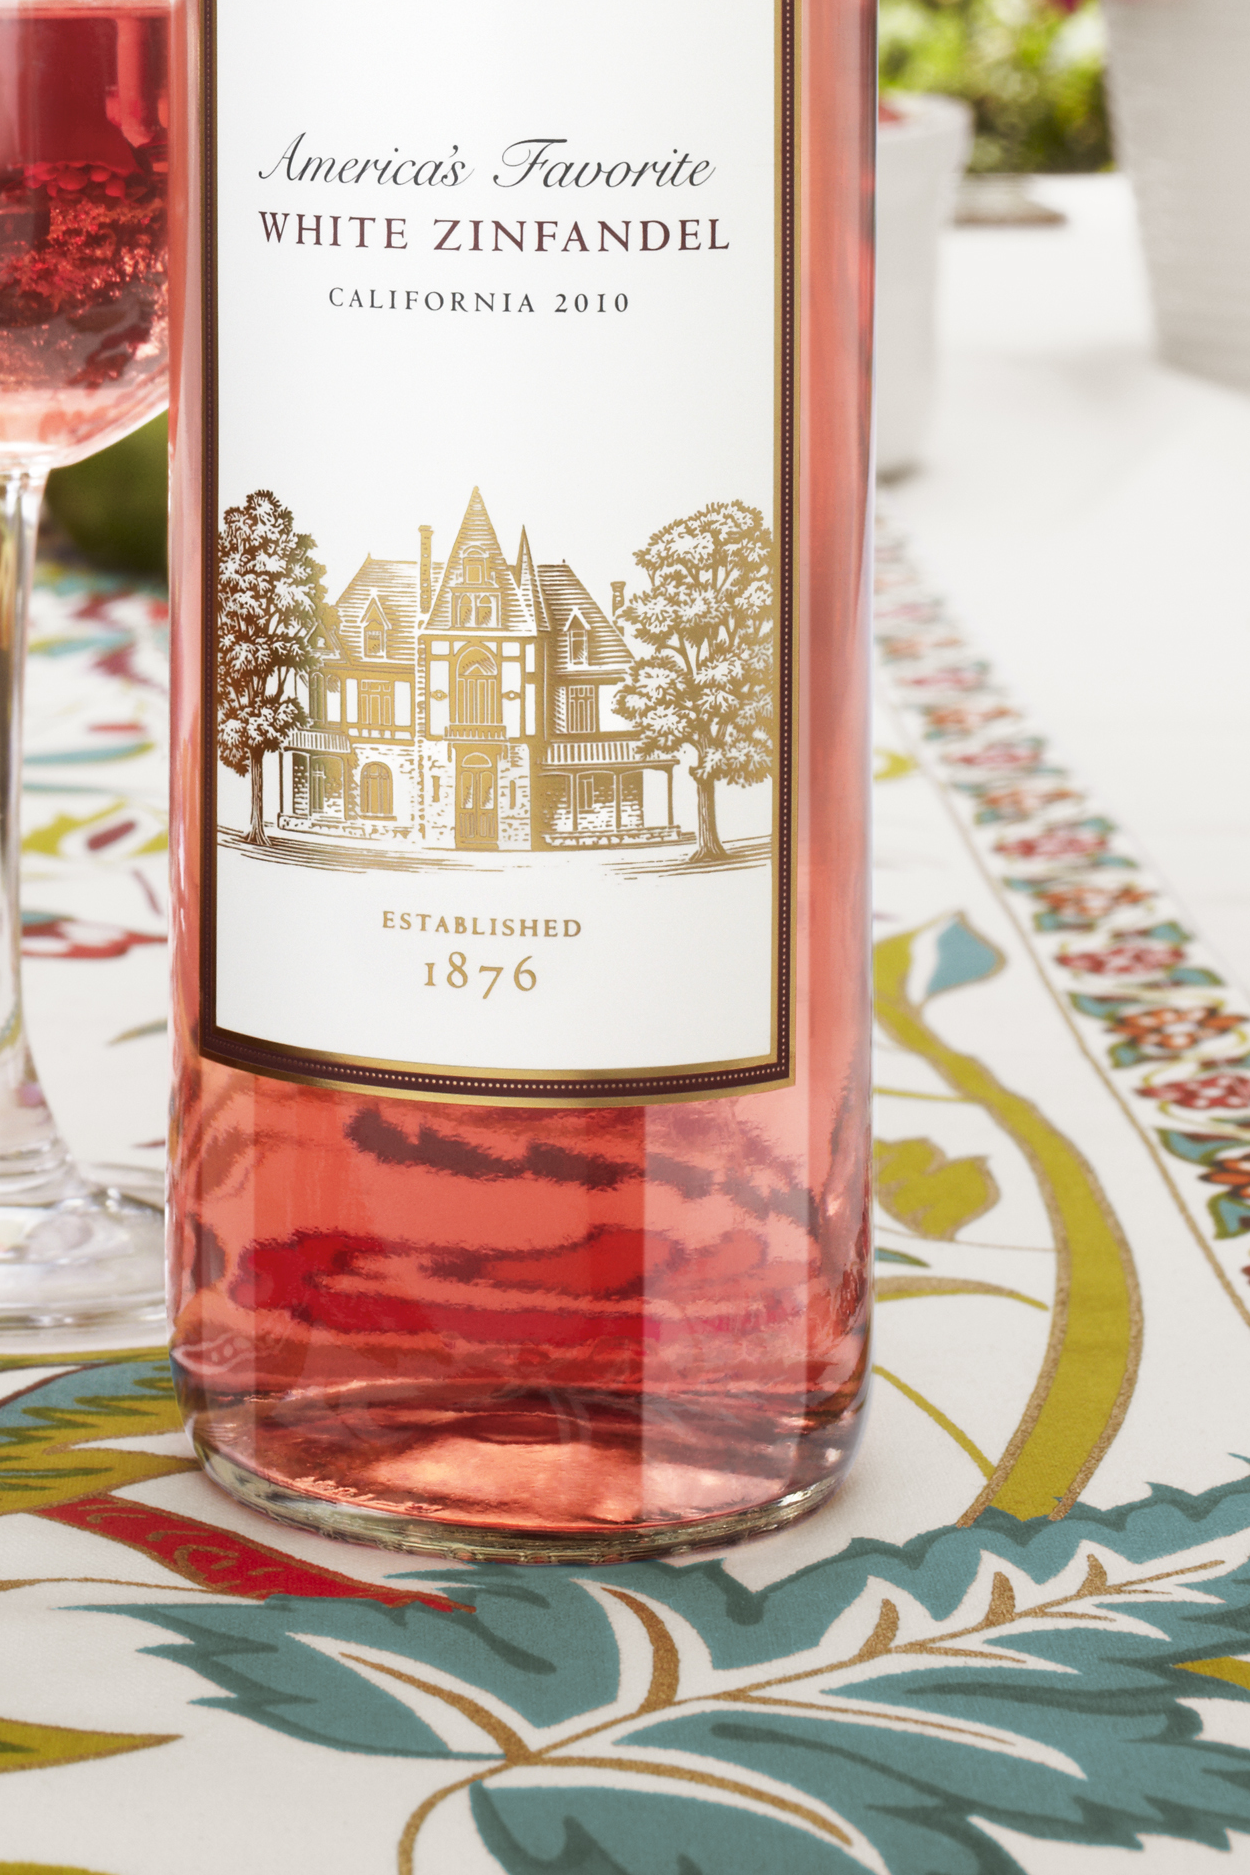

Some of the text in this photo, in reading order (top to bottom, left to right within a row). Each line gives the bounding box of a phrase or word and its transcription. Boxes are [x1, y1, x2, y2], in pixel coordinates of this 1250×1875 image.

[257, 131, 717, 189] America's Favorite
[257, 210, 730, 253] WHITE ZINFANDEL
[328, 286, 629, 314] CALIFORNIA 2010
[382, 910, 582, 938] ESTABLISHED
[423, 950, 537, 1000] 1876
